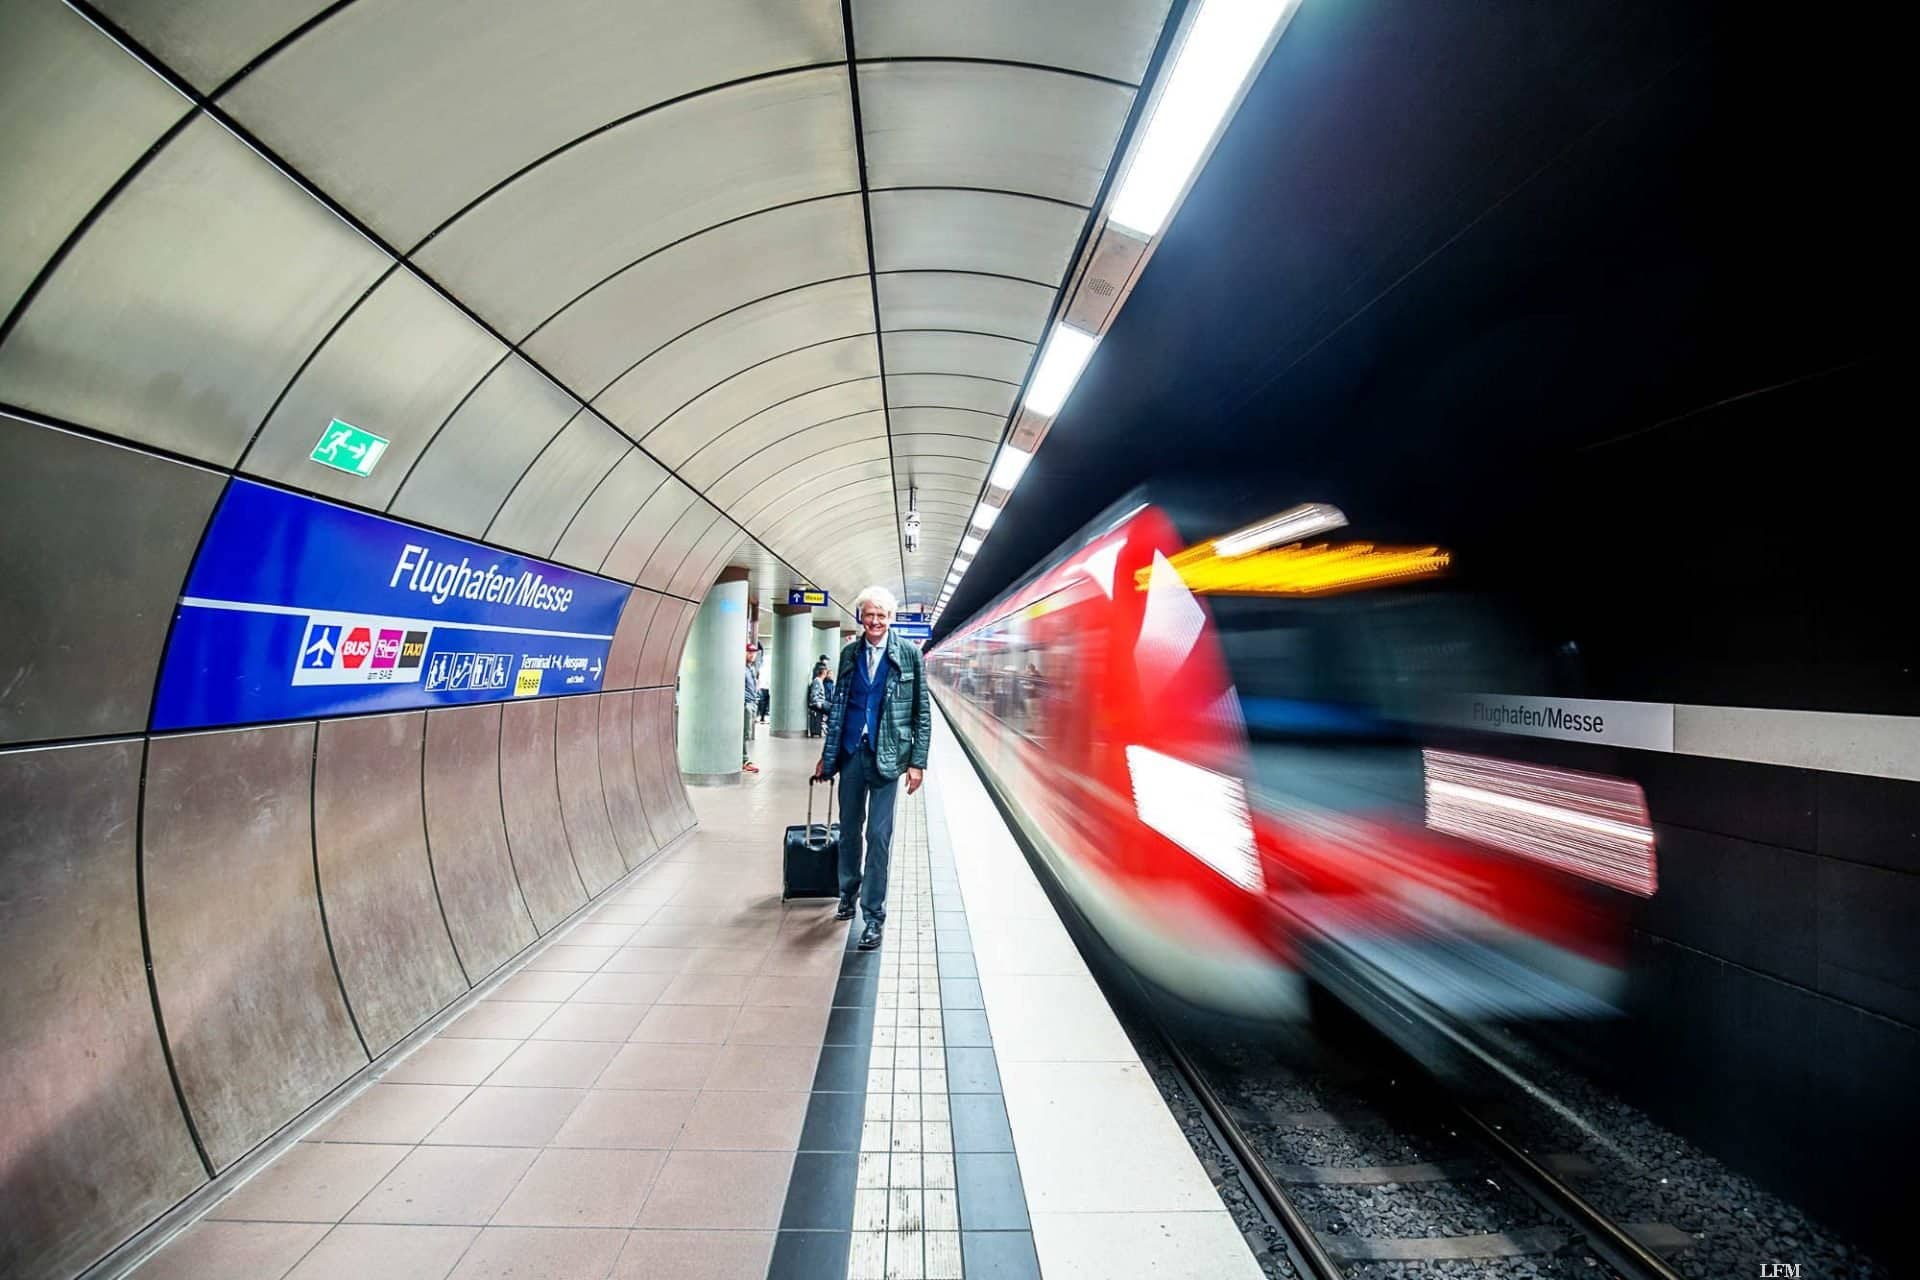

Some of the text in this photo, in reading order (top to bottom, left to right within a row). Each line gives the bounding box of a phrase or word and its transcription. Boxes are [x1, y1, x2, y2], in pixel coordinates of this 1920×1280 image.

[390, 544, 573, 612] Flughafen/Messe
[343, 640, 370, 656] BUS
[402, 643, 424, 656] TAXI
[521, 654, 552, 669] Terminal
[563, 655, 589, 671] Ausgang
[518, 676, 539, 689] Messe
[1473, 702, 1604, 733] Flughafen/Messe
